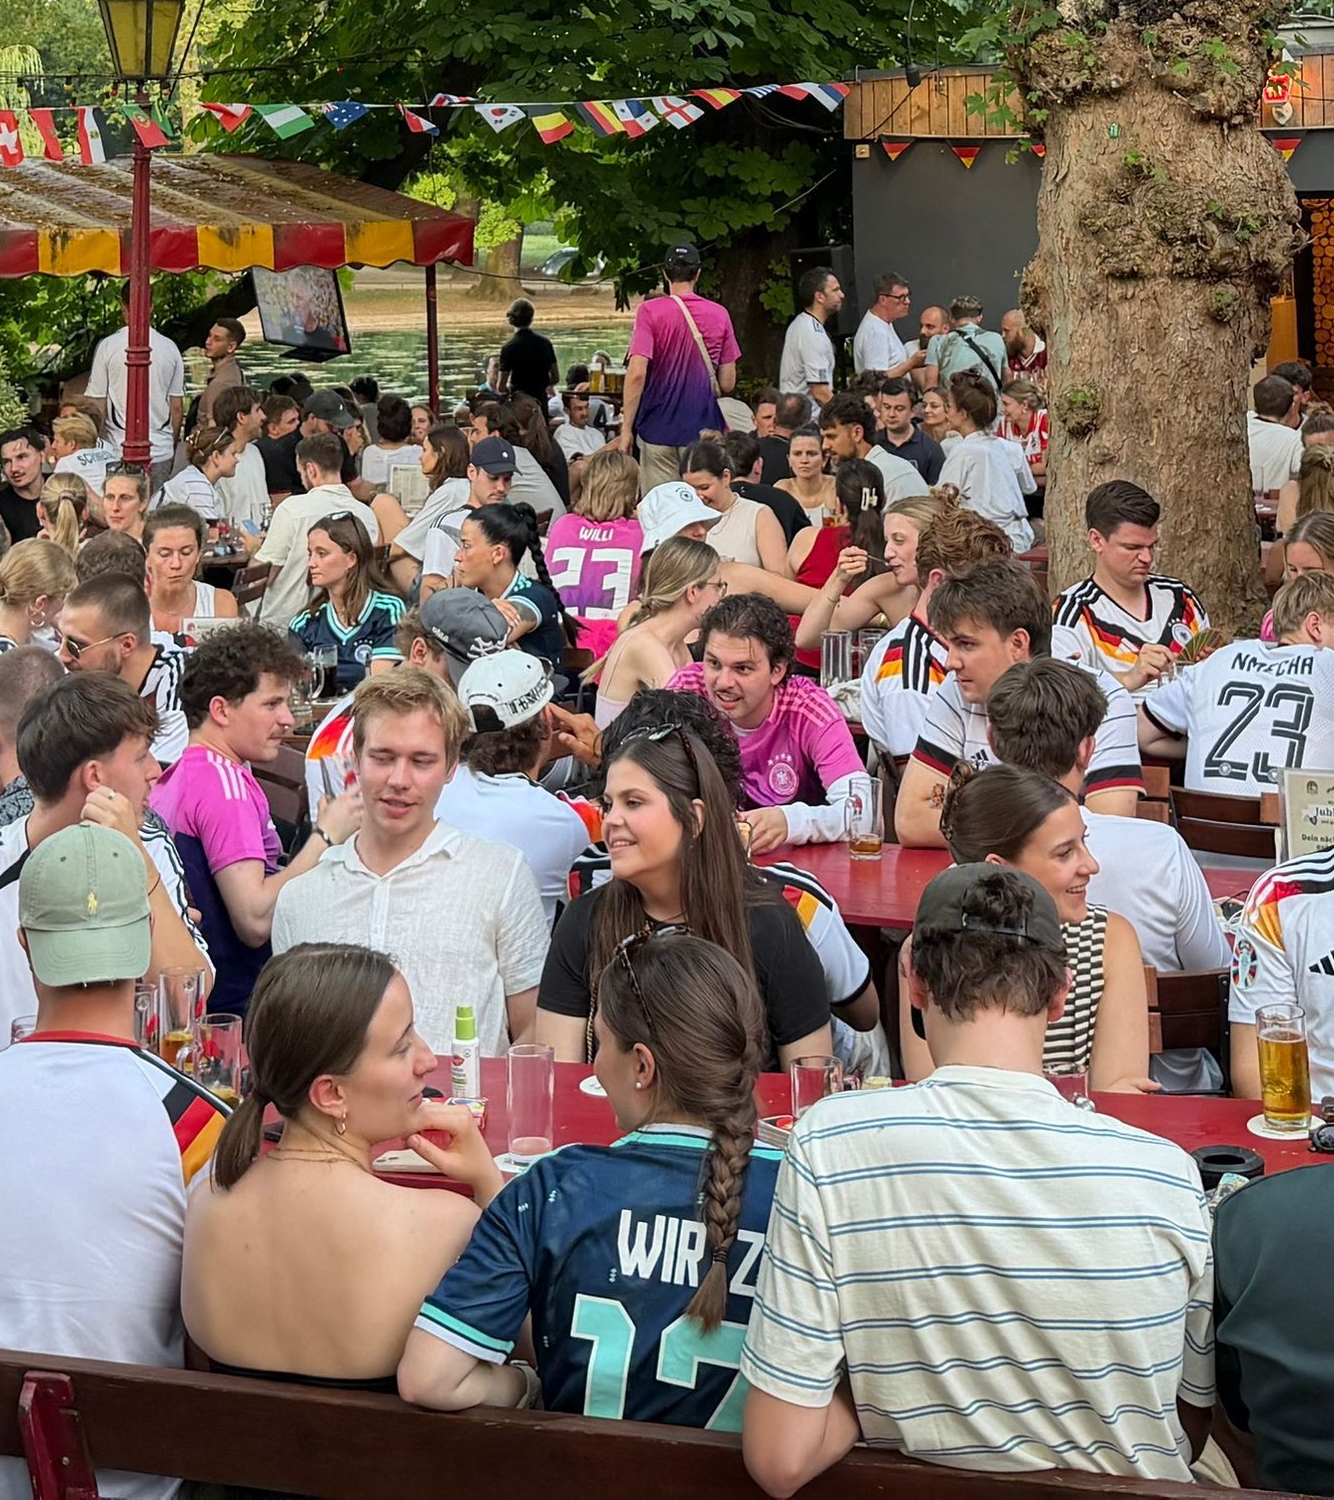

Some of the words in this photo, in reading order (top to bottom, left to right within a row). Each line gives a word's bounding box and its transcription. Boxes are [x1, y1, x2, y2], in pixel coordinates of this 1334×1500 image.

[579, 526, 614, 541] WILLI
[550, 546, 633, 619] 23
[1203, 680, 1315, 784] 23
[617, 1208, 766, 1298] WIRZ
